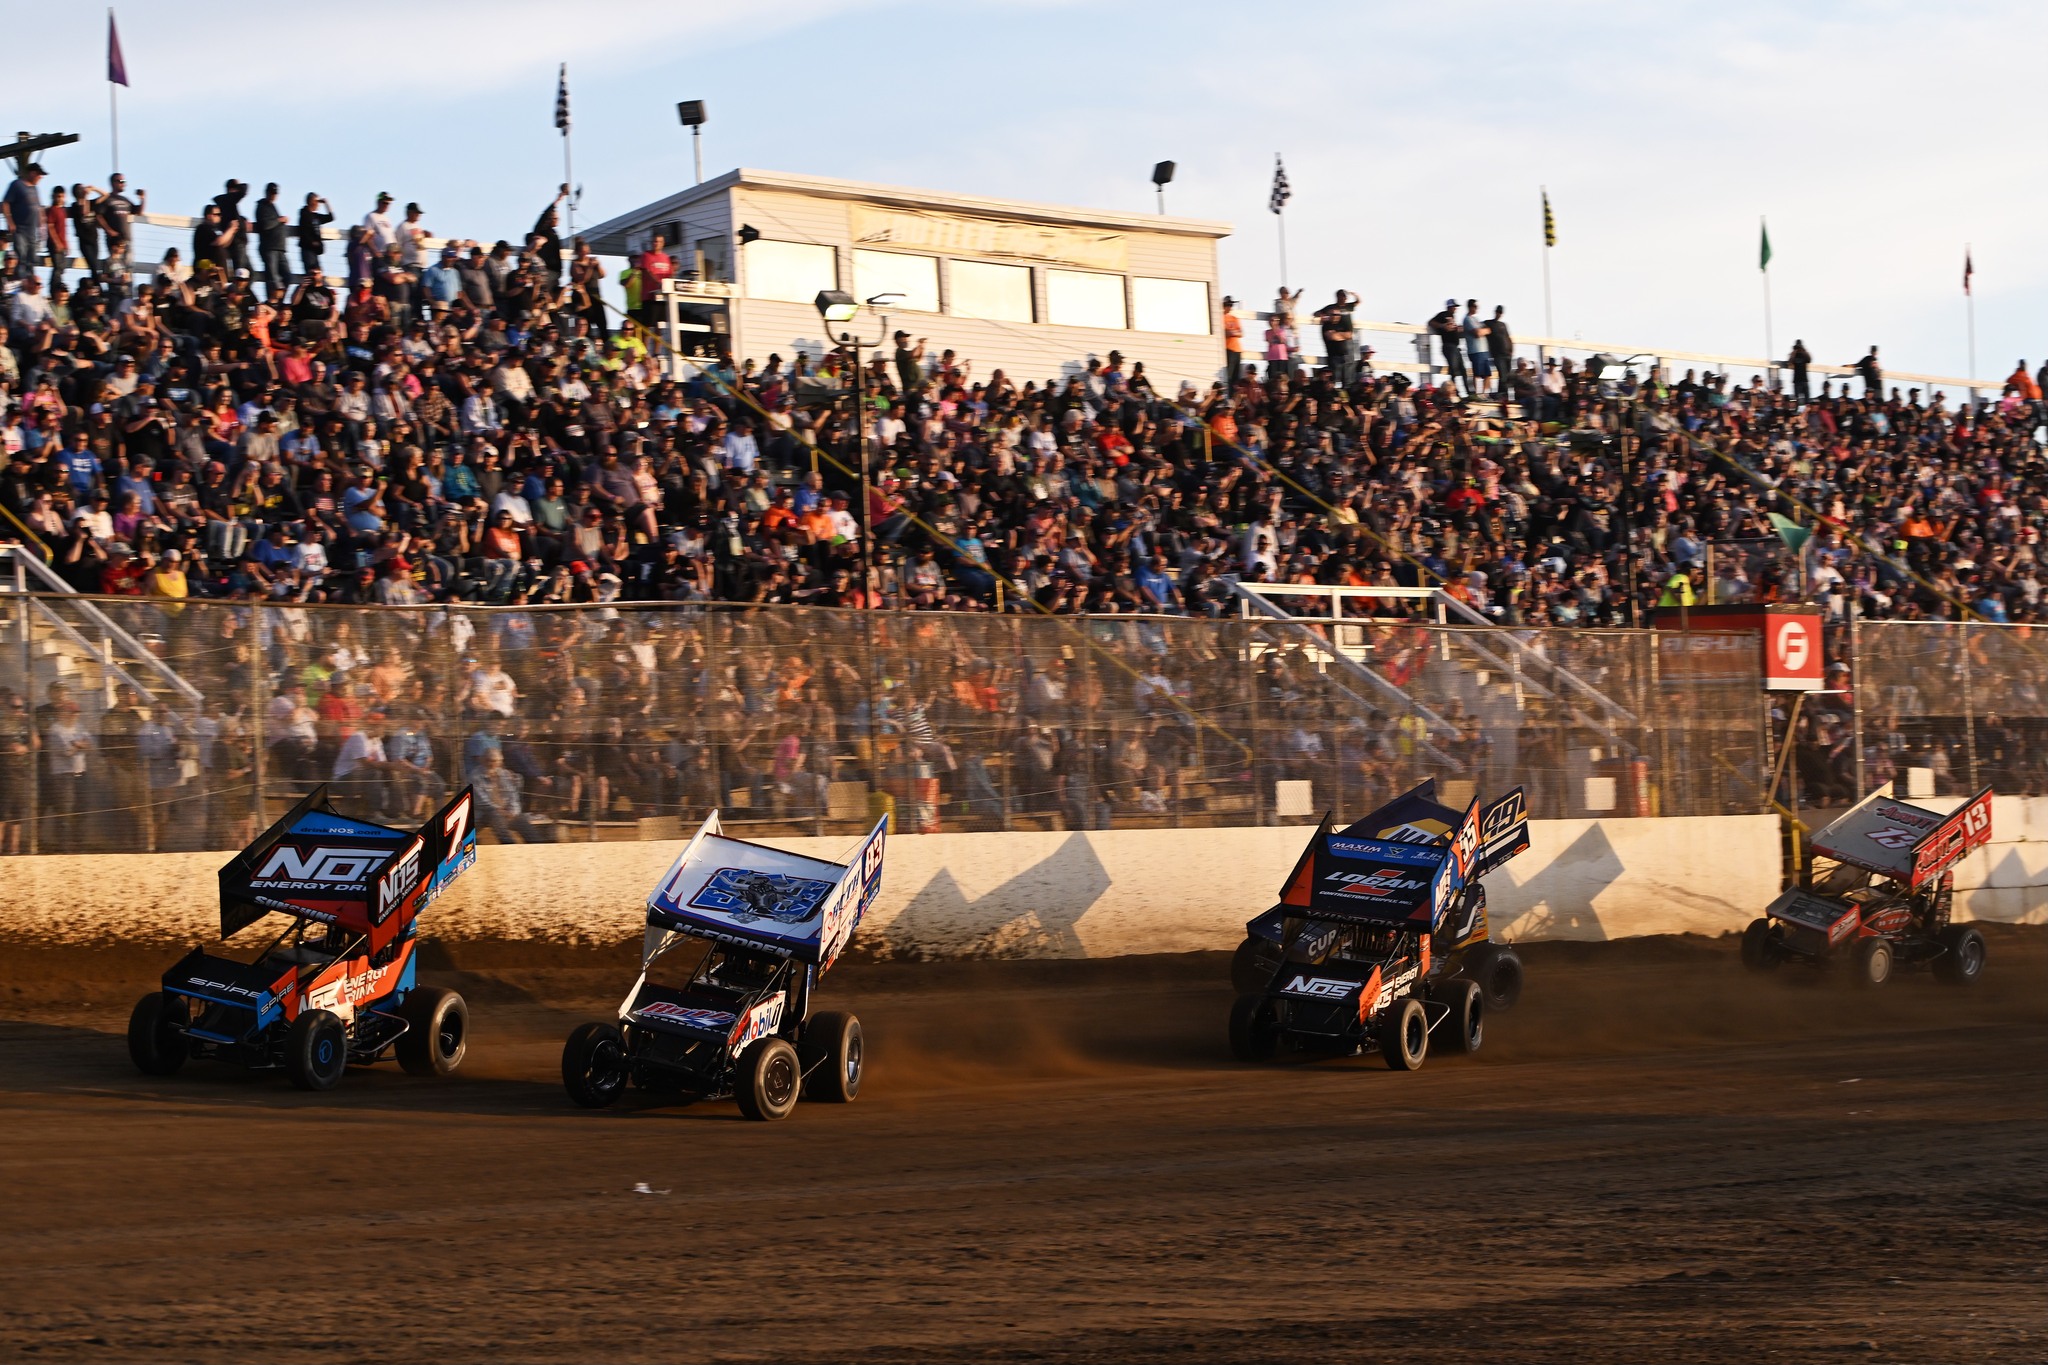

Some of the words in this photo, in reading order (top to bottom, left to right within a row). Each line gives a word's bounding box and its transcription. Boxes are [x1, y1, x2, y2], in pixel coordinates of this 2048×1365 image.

[445, 793, 471, 863] 7
[1485, 797, 1518, 838] 49
[1963, 802, 1989, 837] 13
[300, 827, 382, 837] drinkNOS.com
[865, 829, 884, 883] 83
[1331, 842, 1382, 853] MAXIM
[249, 880, 332, 891] ENERGY
[379, 836, 425, 914] NOS
[1324, 871, 1428, 890] LOGAN
[254, 894, 339, 922] SUNSHINE
[1319, 890, 1371, 902] CONTRACTORS
[1306, 909, 1407, 928] WINDOM
[673, 922, 793, 958] McFADDEN
[187, 977, 261, 999] SPIRE
[343, 965, 389, 993] ENERGY
[1284, 975, 1363, 998] NOS
[260, 981, 296, 1016] SPIRE
